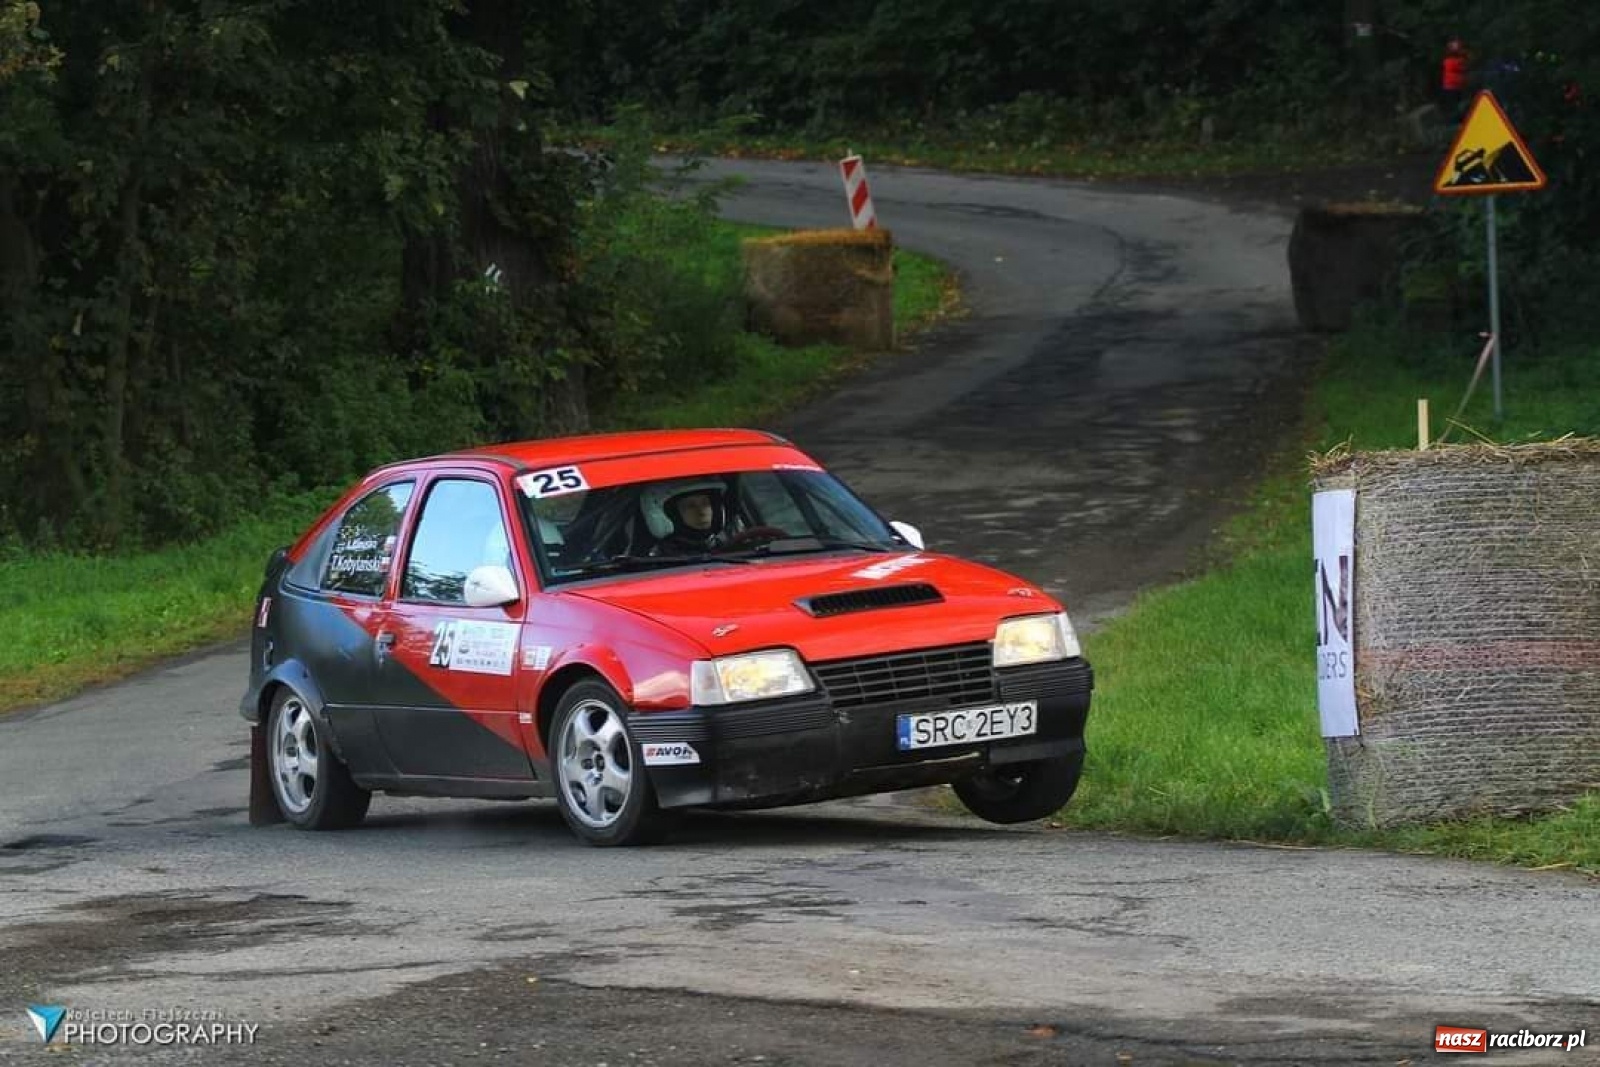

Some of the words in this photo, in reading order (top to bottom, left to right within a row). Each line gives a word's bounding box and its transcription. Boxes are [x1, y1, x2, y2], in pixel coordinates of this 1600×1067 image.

[532, 467, 582, 493] 25
[430, 621, 455, 668] 25
[915, 713, 967, 745] SRC
[975, 705, 1033, 738] 2EY3
